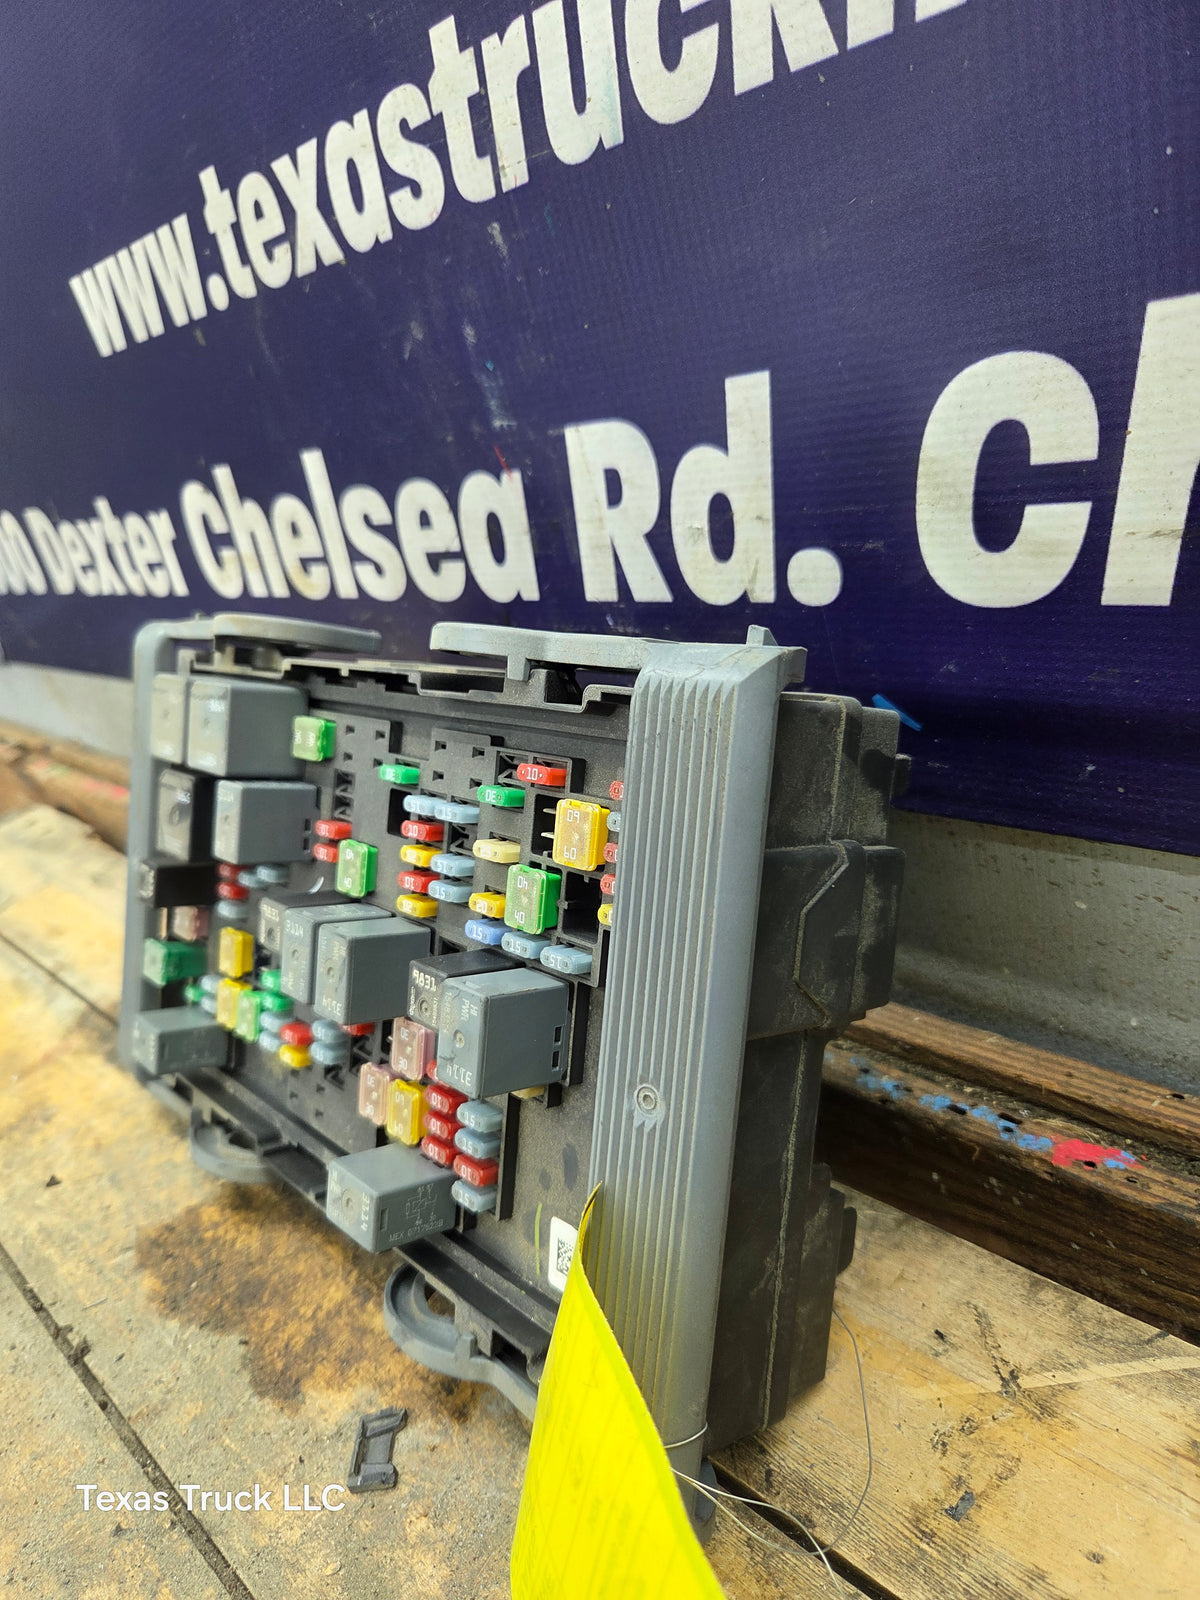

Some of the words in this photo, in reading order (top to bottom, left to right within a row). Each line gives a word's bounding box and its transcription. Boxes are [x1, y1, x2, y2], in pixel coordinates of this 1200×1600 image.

[70, 0, 968, 357] www.texastruc
[22, 494, 190, 598] Dexter
[180, 446, 541, 601] Chelsea
[564, 370, 844, 606] Rd.
[526, 767, 539, 781] 10
[485, 789, 497, 803] 30
[566, 810, 580, 824] 60
[563, 845, 577, 860] 60
[517, 875, 528, 890] 40
[475, 899, 488, 914] 20
[514, 909, 526, 924] 40
[472, 925, 483, 941] 15
[509, 938, 521, 953] 15
[550, 955, 563, 969] 15
[412, 969, 437, 992] 9831
